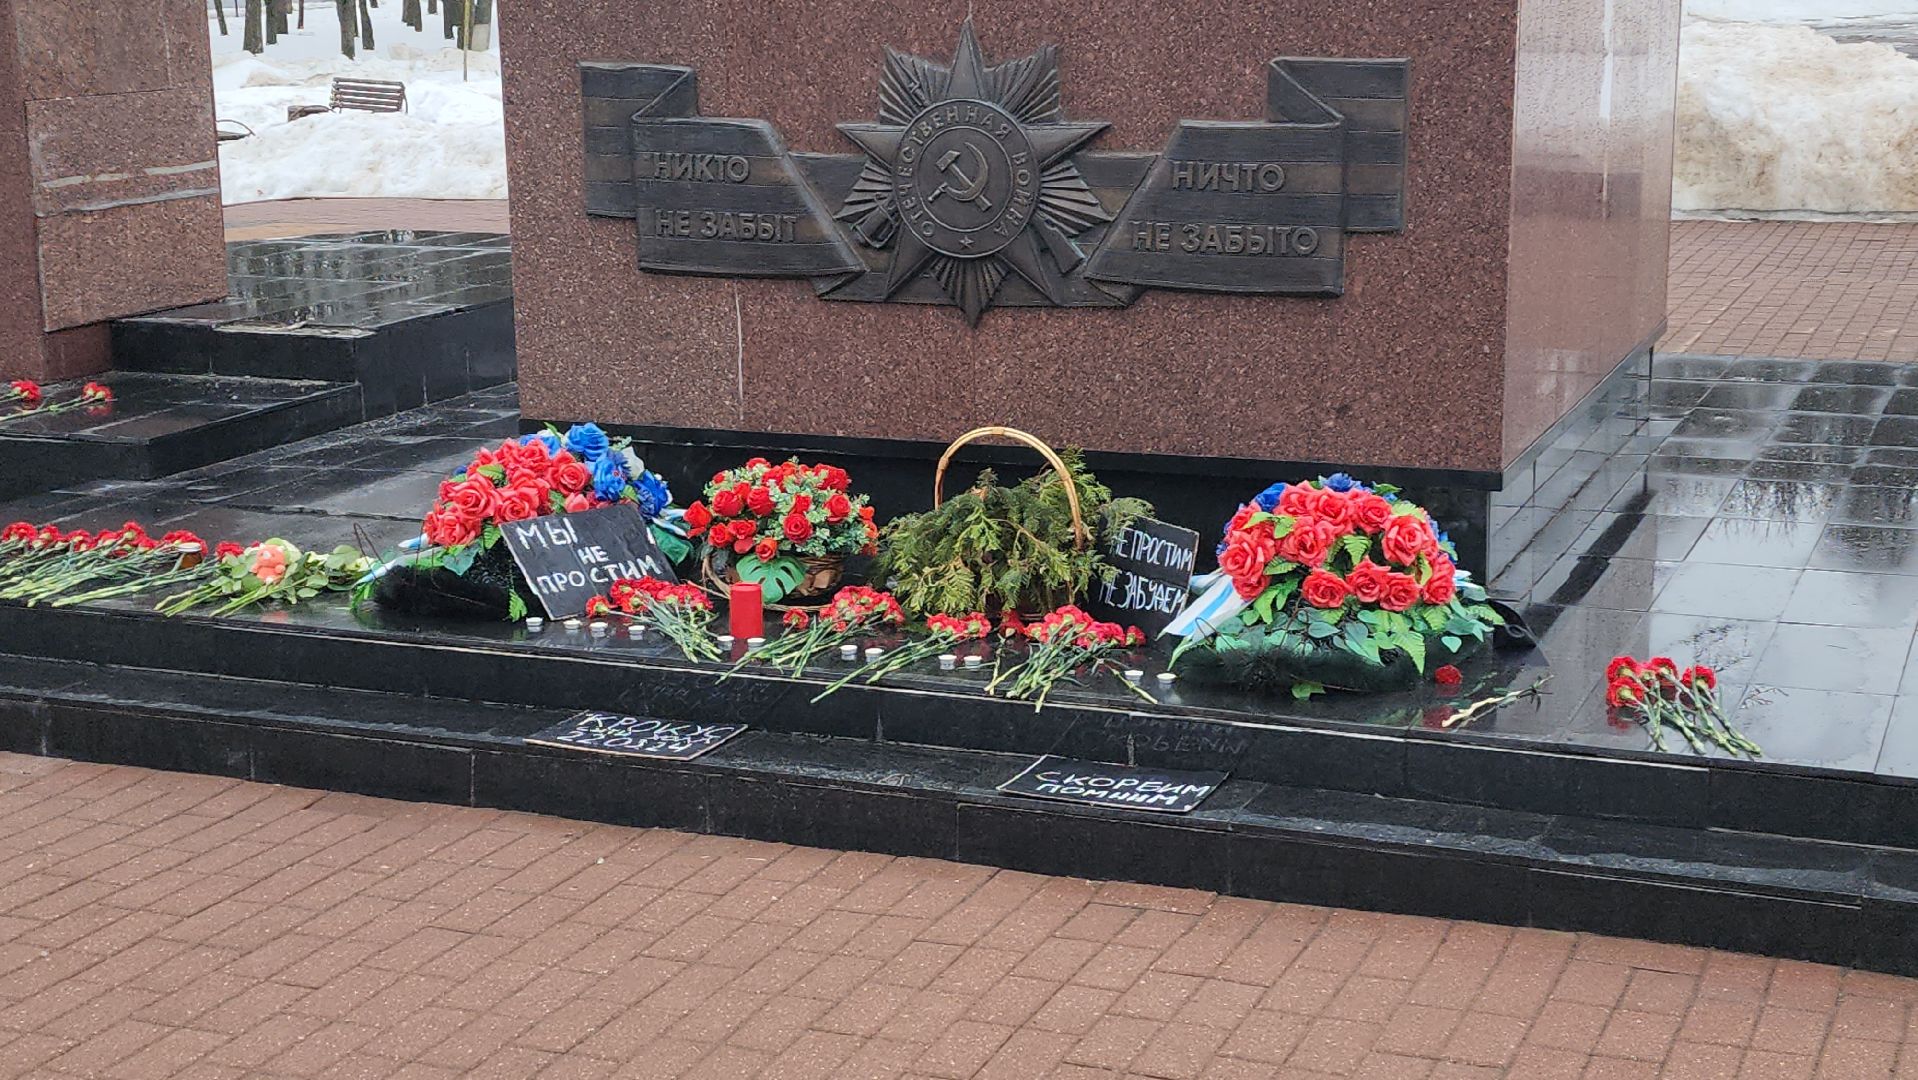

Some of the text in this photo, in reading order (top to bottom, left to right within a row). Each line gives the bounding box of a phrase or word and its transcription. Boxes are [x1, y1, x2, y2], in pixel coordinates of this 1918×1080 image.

[653, 154, 751, 184] НИКТО
[1171, 161, 1287, 192] НИЧТО
[653, 209, 797, 243] НЕ ЗАБЫТ
[1132, 221, 1320, 257] НЕ ЗАБЫТО
[515, 517, 578, 550] МЫ
[577, 545, 610, 565] НЕ
[1131, 530, 1193, 572] ПРОСТИМ
[536, 554, 662, 595] ПРОСТИМ
[576, 713, 735, 738] КРОКУС
[1035, 771, 1211, 797] СКОРБИМ
[1035, 782, 1180, 806] ПОМНИМ
